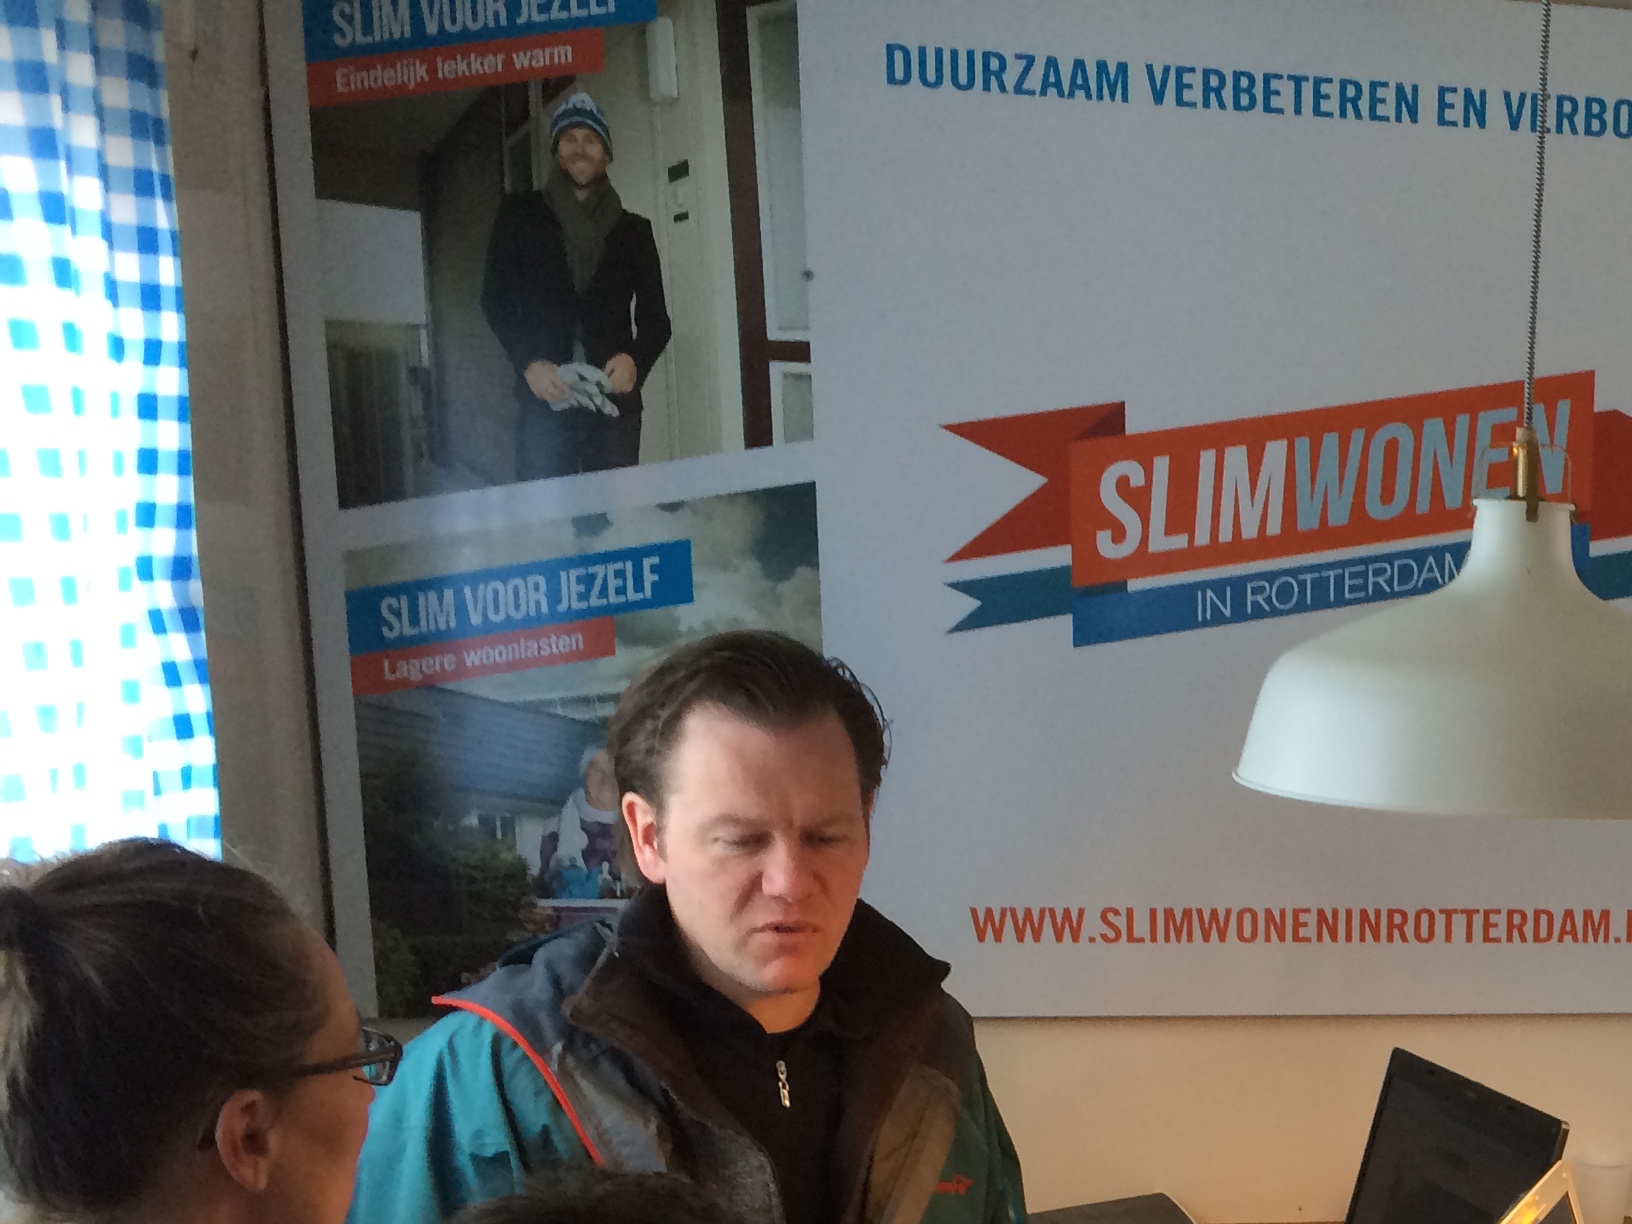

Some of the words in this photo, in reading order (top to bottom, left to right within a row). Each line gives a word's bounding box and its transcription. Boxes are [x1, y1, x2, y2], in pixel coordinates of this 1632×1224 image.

[332, 0, 411, 47] SLIM
[336, 60, 429, 93] Eindelijk
[437, 53, 504, 79] lekker
[512, 44, 573, 70] warm
[886, 43, 1130, 104] DUURZAAM
[1144, 63, 1419, 125] VERBETEREN
[1437, 86, 1487, 130] EN
[1095, 399, 1572, 560] SLIMWONEN
[381, 589, 456, 640] SLIM
[465, 573, 549, 625] VOOR
[557, 556, 660, 613] JEZELF
[1197, 585, 1232, 622] IN
[383, 653, 457, 682] Lagere
[463, 629, 584, 667] woonlasten
